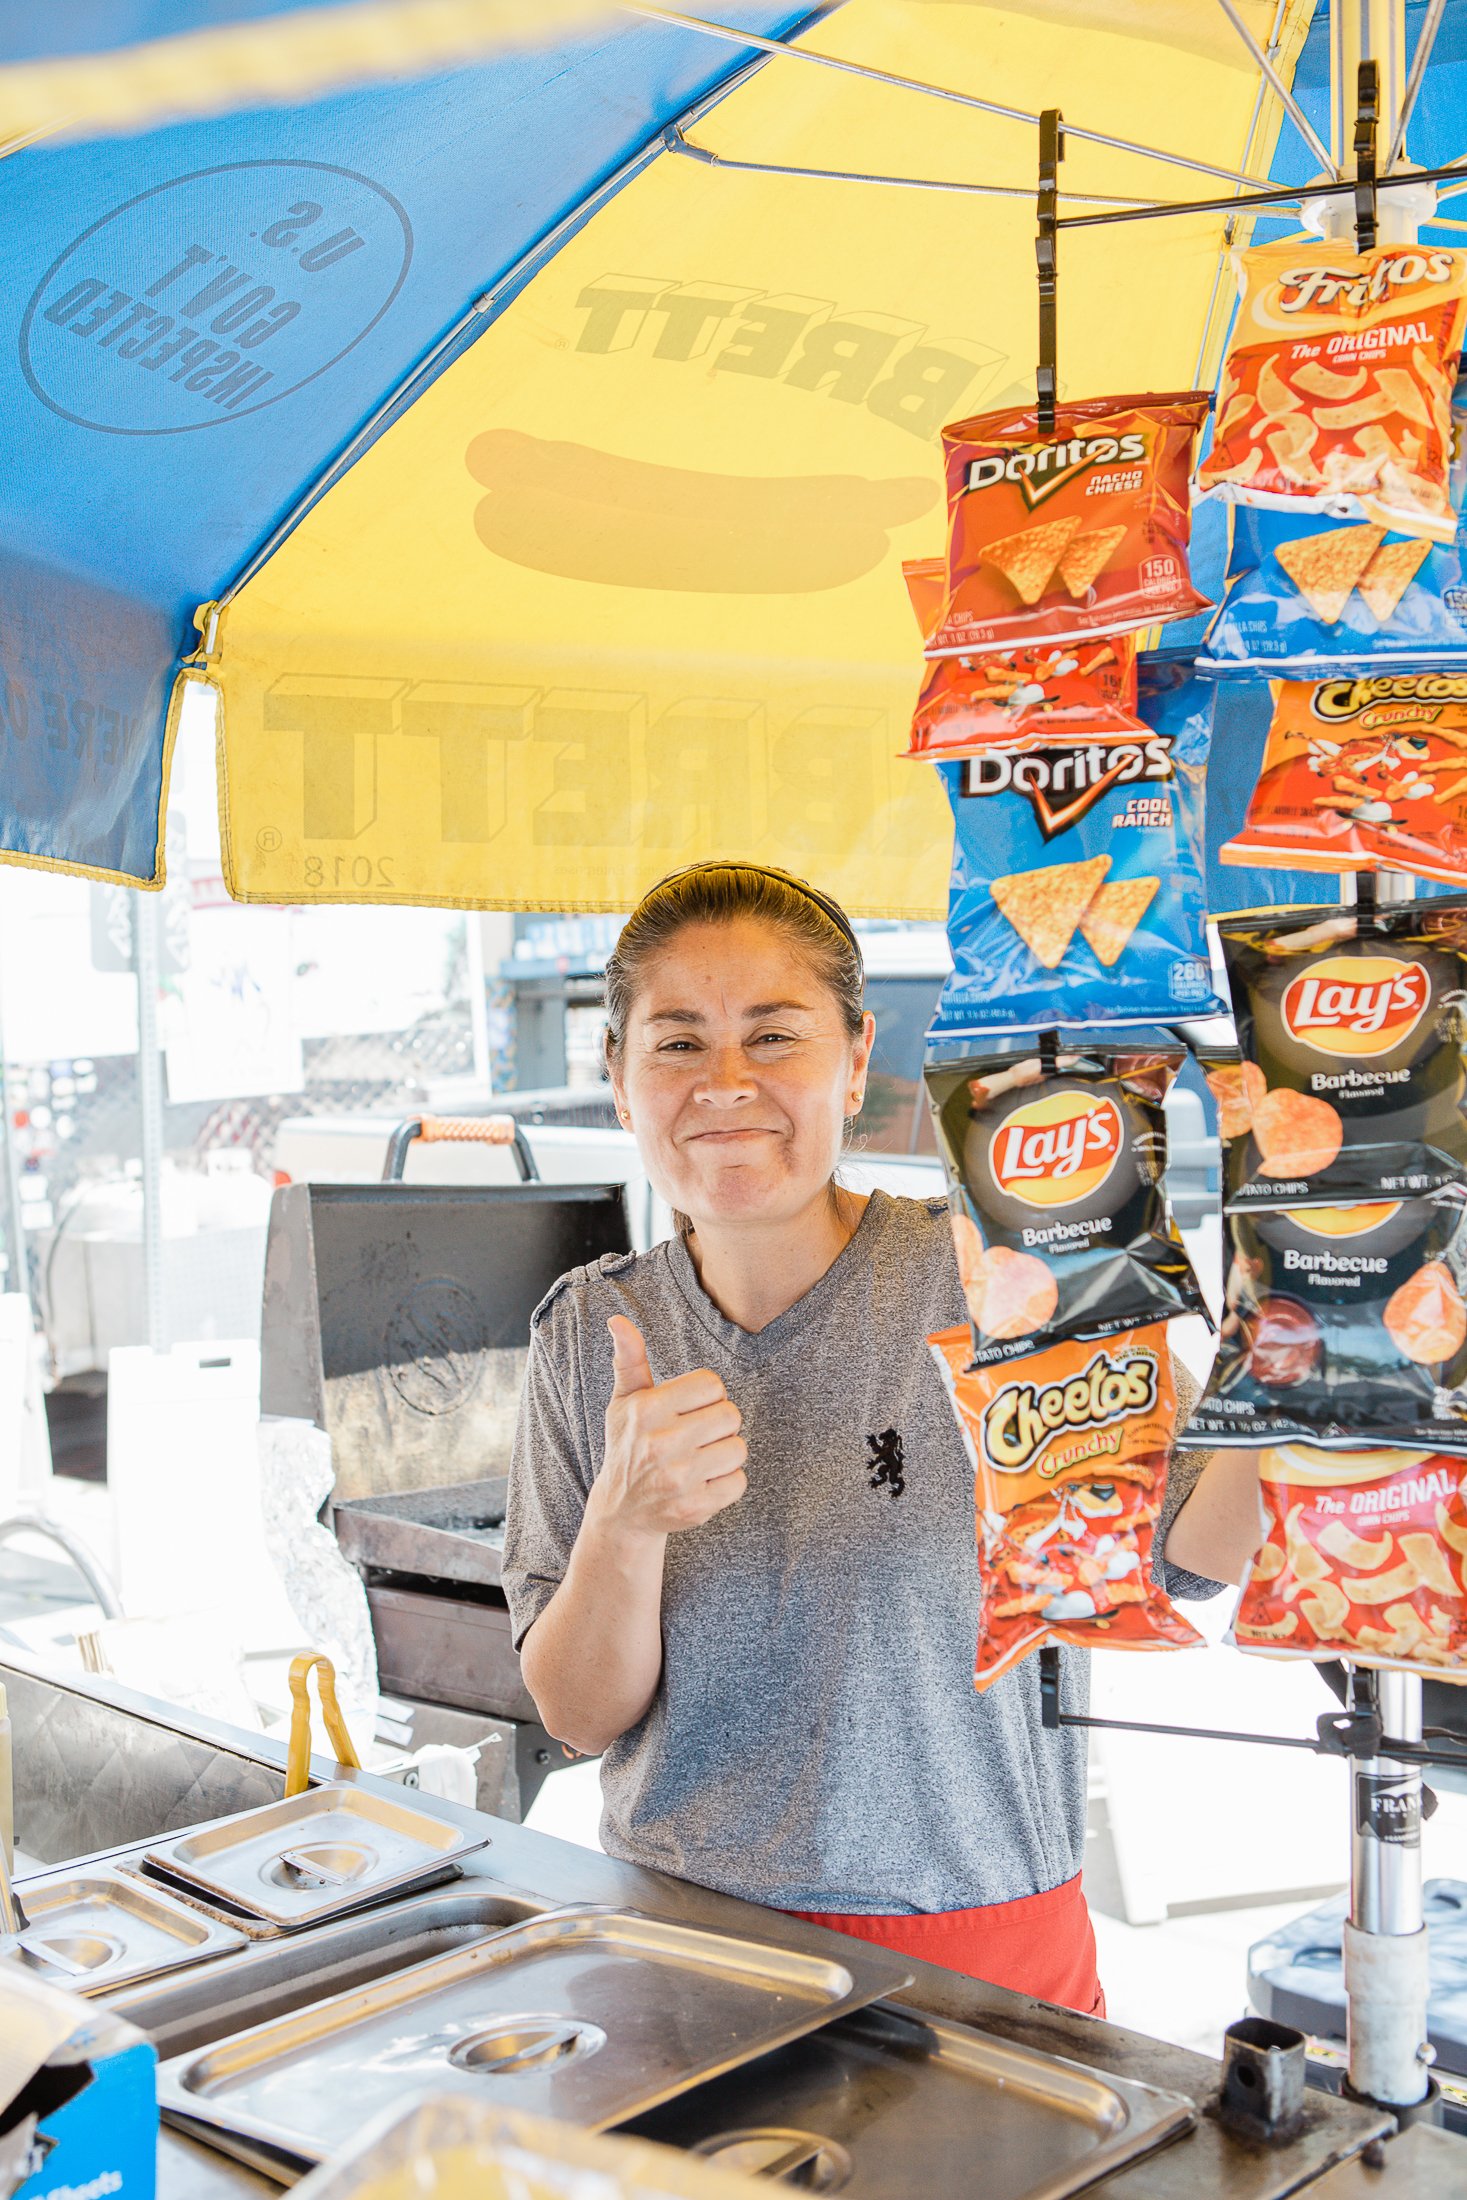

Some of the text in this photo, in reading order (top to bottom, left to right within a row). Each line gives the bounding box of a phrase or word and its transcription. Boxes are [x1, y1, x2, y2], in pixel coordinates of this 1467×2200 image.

[1278, 253, 1454, 313] Fritos
[1291, 321, 1435, 360] The ORIGINAL
[1358, 348, 1387, 361] CHIPS
[968, 433, 1146, 491] Doritos
[1084, 478, 1143, 496] CHEESE
[1089, 469, 1143, 487] NACHO
[1144, 557, 1175, 577] 150
[1359, 703, 1443, 729] Crunchy
[968, 737, 1175, 794] Doritos
[1126, 797, 1171, 813] COOL
[1111, 811, 1173, 829] RANCH
[1173, 961, 1207, 982] 260
[1292, 971, 1420, 1034] Lay's
[1310, 1067, 1412, 1092] Barbecue
[1000, 1108, 1114, 1180] Lay's
[1235, 1180, 1309, 1198] TATO CHIPS
[1380, 1175, 1407, 1190] NET
[1022, 1216, 1113, 1248] Barbecue
[1283, 1249, 1389, 1275] Barbecue
[1307, 1273, 1361, 1288] Flavored
[973, 1346, 1004, 1365] TATO
[985, 1352, 1155, 1470] Cheetos
[1036, 1425, 1125, 1479] Crunchy
[1314, 1468, 1458, 1515] The ORIGINAL
[1382, 1509, 1410, 1525] CHIPS
[1370, 1796, 1418, 1813] FRAN
